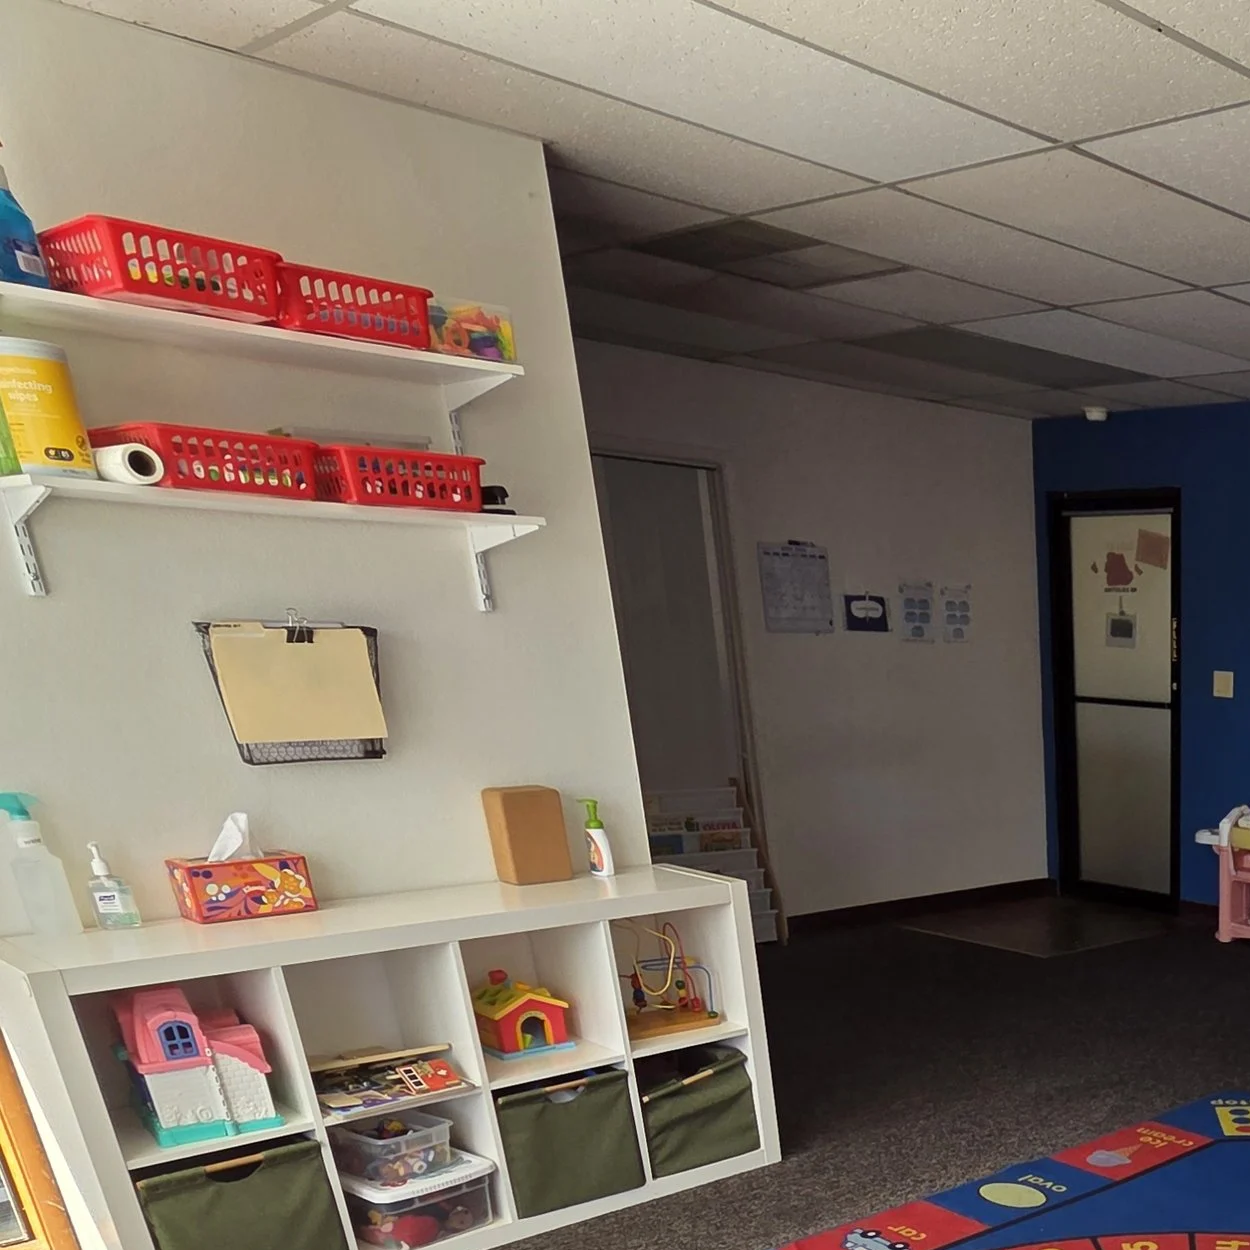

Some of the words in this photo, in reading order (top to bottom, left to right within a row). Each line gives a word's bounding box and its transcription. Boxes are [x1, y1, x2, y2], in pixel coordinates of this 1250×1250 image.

[1136, 1128, 1194, 1147] cream
[1140, 1136, 1168, 1148] ice
[1017, 1174, 1067, 1193] oval
[889, 1225, 926, 1240] car
